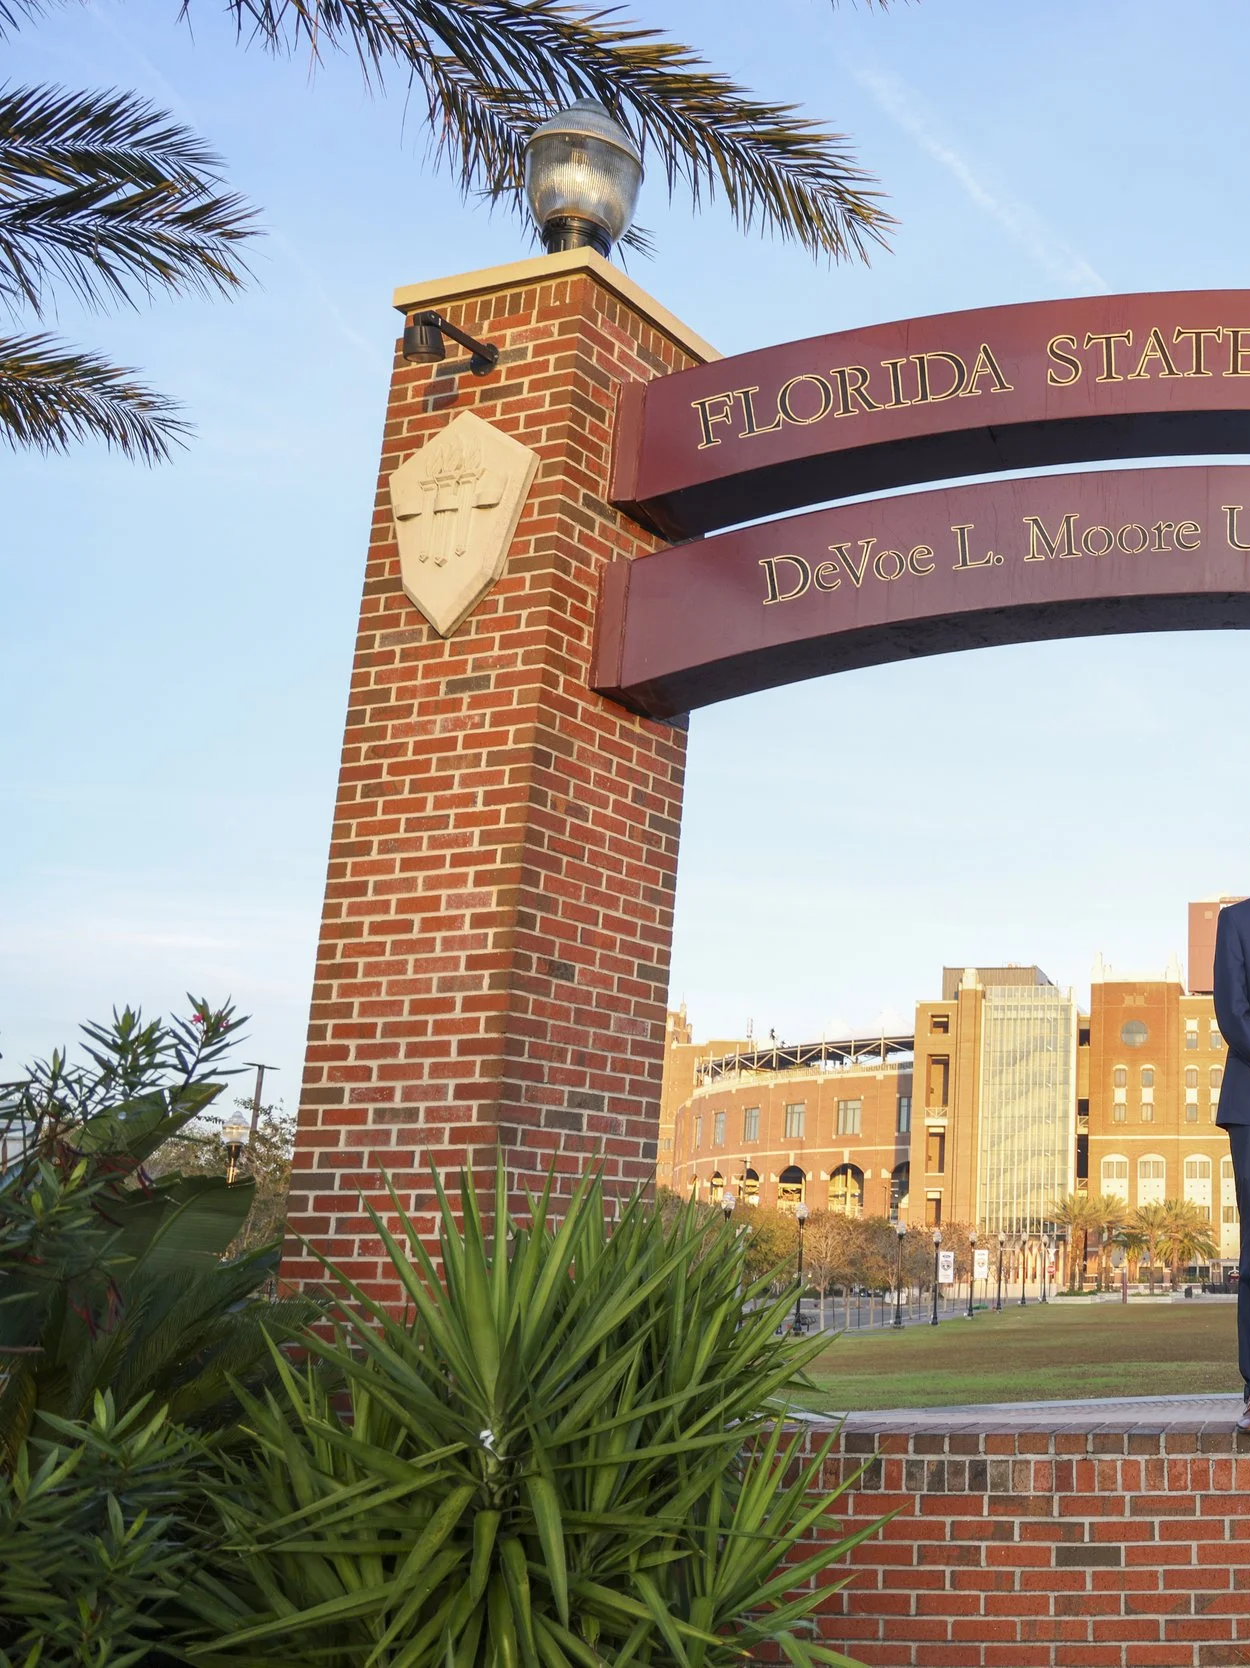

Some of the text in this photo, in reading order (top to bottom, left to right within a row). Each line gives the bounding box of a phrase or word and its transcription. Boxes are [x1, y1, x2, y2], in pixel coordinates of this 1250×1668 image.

[691, 344, 1014, 450] FLORIDA
[758, 537, 936, 605] DeVoe
[951, 523, 1005, 572] L.
[1022, 512, 1202, 563] Moore
